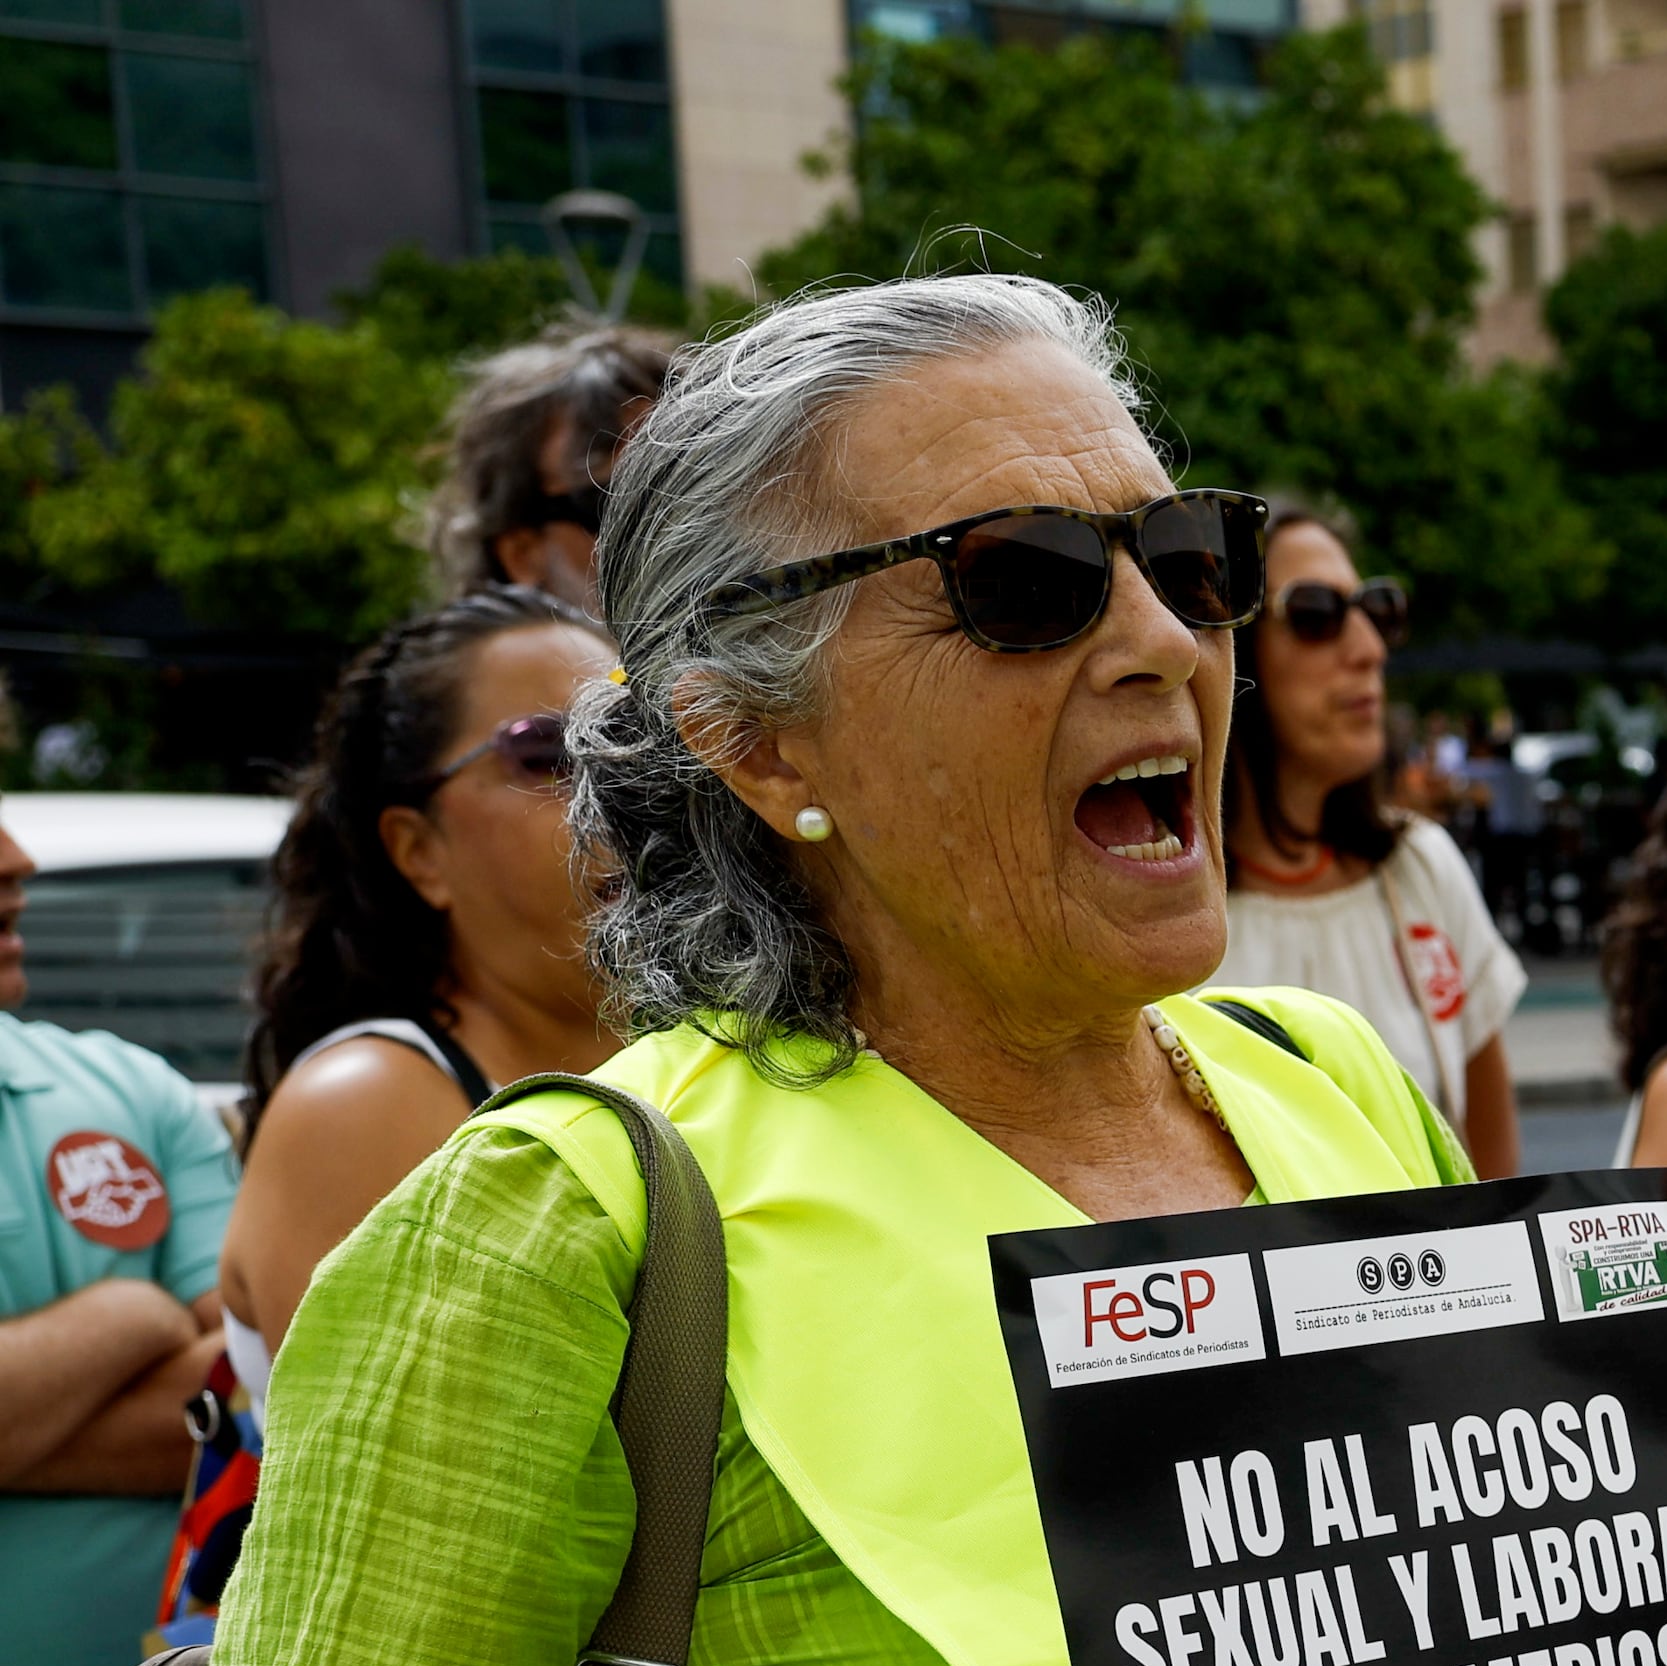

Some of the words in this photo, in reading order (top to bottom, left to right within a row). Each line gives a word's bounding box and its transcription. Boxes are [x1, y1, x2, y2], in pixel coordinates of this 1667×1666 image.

[1569, 1212, 1666, 1245] SPA-RTVA
[1640, 1250, 1655, 1259] UNA
[1597, 1260, 1661, 1291] RTVA
[1083, 1269, 1216, 1348] FeSP
[1295, 1311, 1350, 1331] Sindicato
[1355, 1309, 1367, 1323] de
[1372, 1302, 1436, 1321] Periodistas
[1441, 1299, 1453, 1311] de
[1599, 1301, 1616, 1312] de
[1620, 1285, 1667, 1306] calidad
[1056, 1356, 1113, 1374] Federación
[1115, 1354, 1128, 1366] de
[1130, 1348, 1181, 1363] Sindicatos
[1183, 1345, 1195, 1356] de
[1197, 1339, 1249, 1355] Periodistas
[1175, 1448, 1286, 1568] NO
[1304, 1433, 1397, 1547] AL
[1407, 1393, 1638, 1528] ACOSO
[1387, 1549, 1436, 1651] Y
